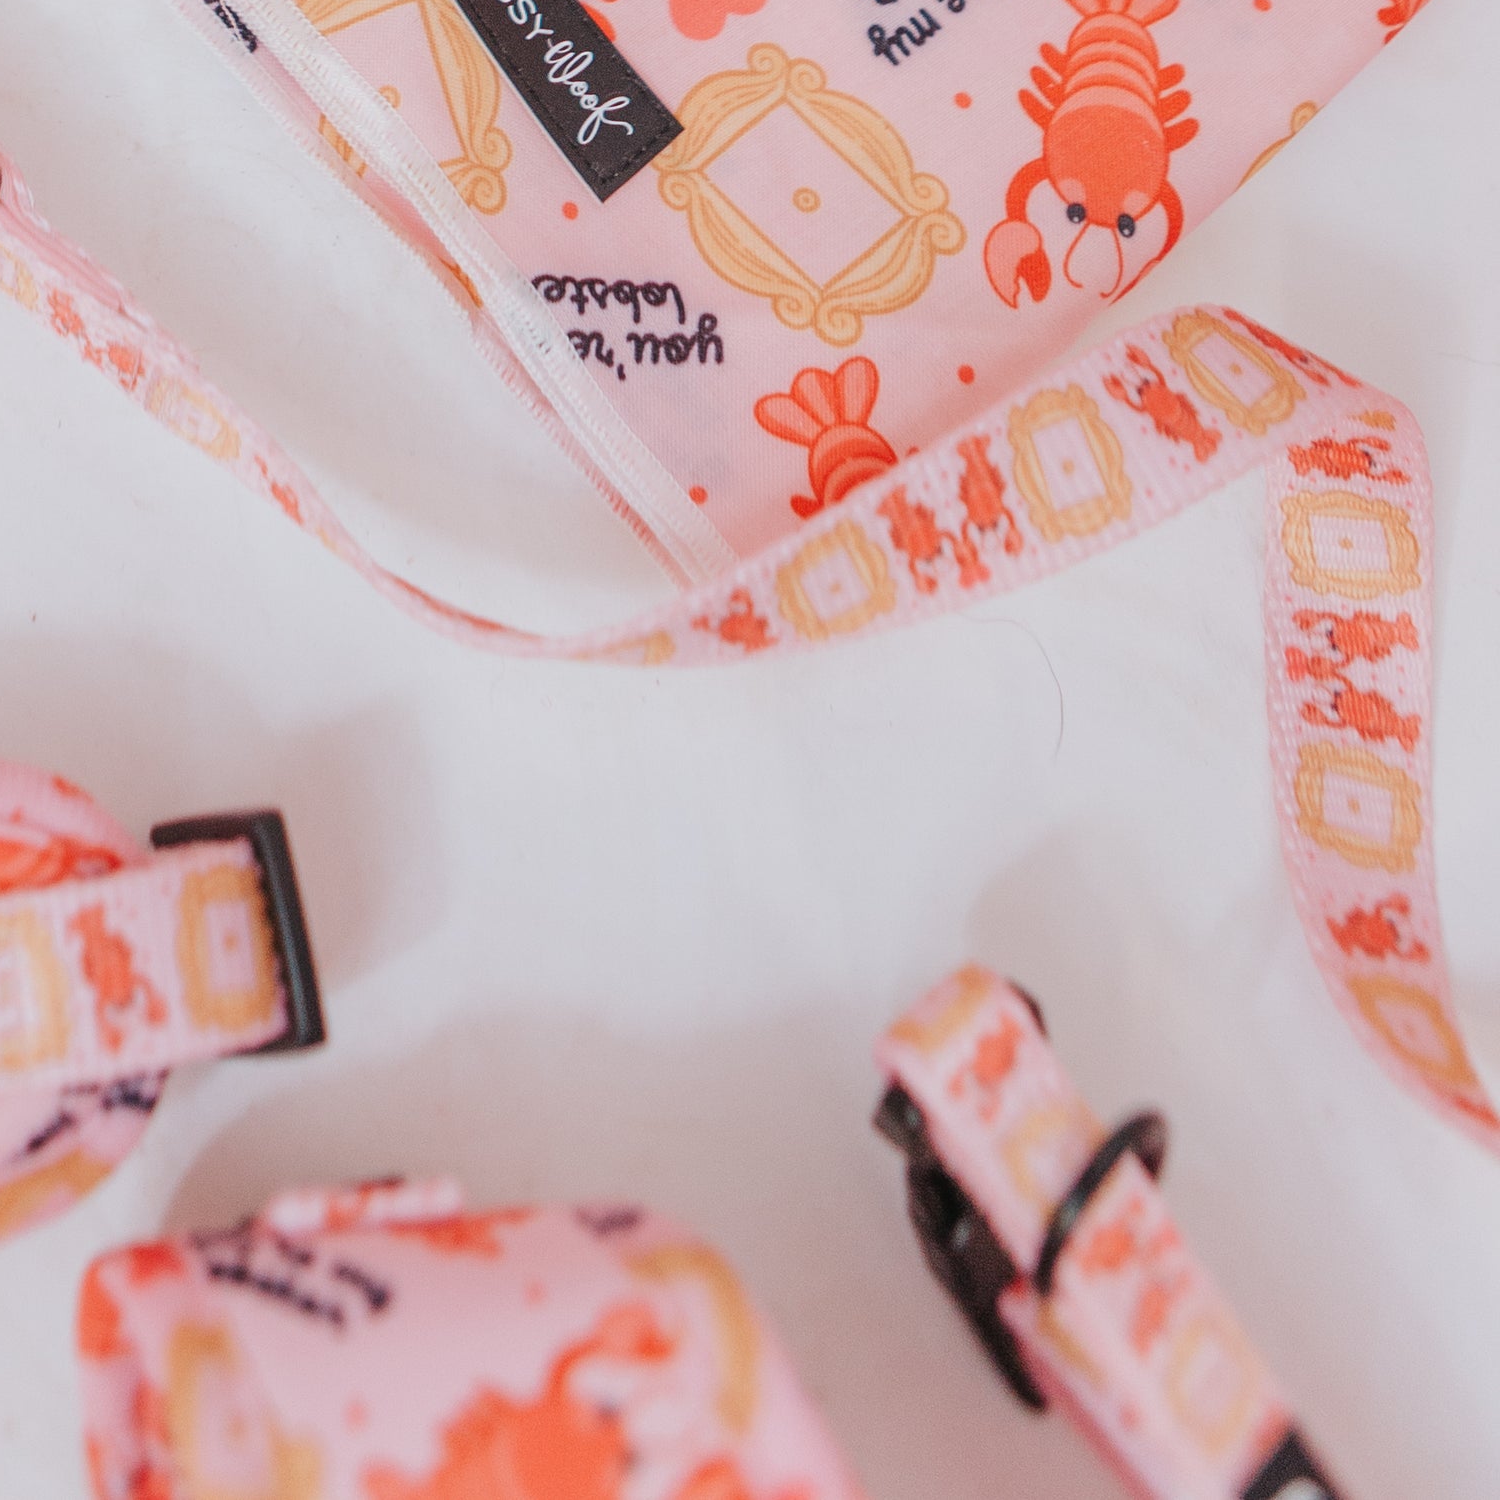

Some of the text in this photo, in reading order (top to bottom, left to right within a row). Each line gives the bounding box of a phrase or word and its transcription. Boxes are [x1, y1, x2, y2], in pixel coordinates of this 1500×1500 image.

[865, 9, 941, 67] my
[542, 39, 636, 146] Woof
[531, 273, 687, 325] lobste
